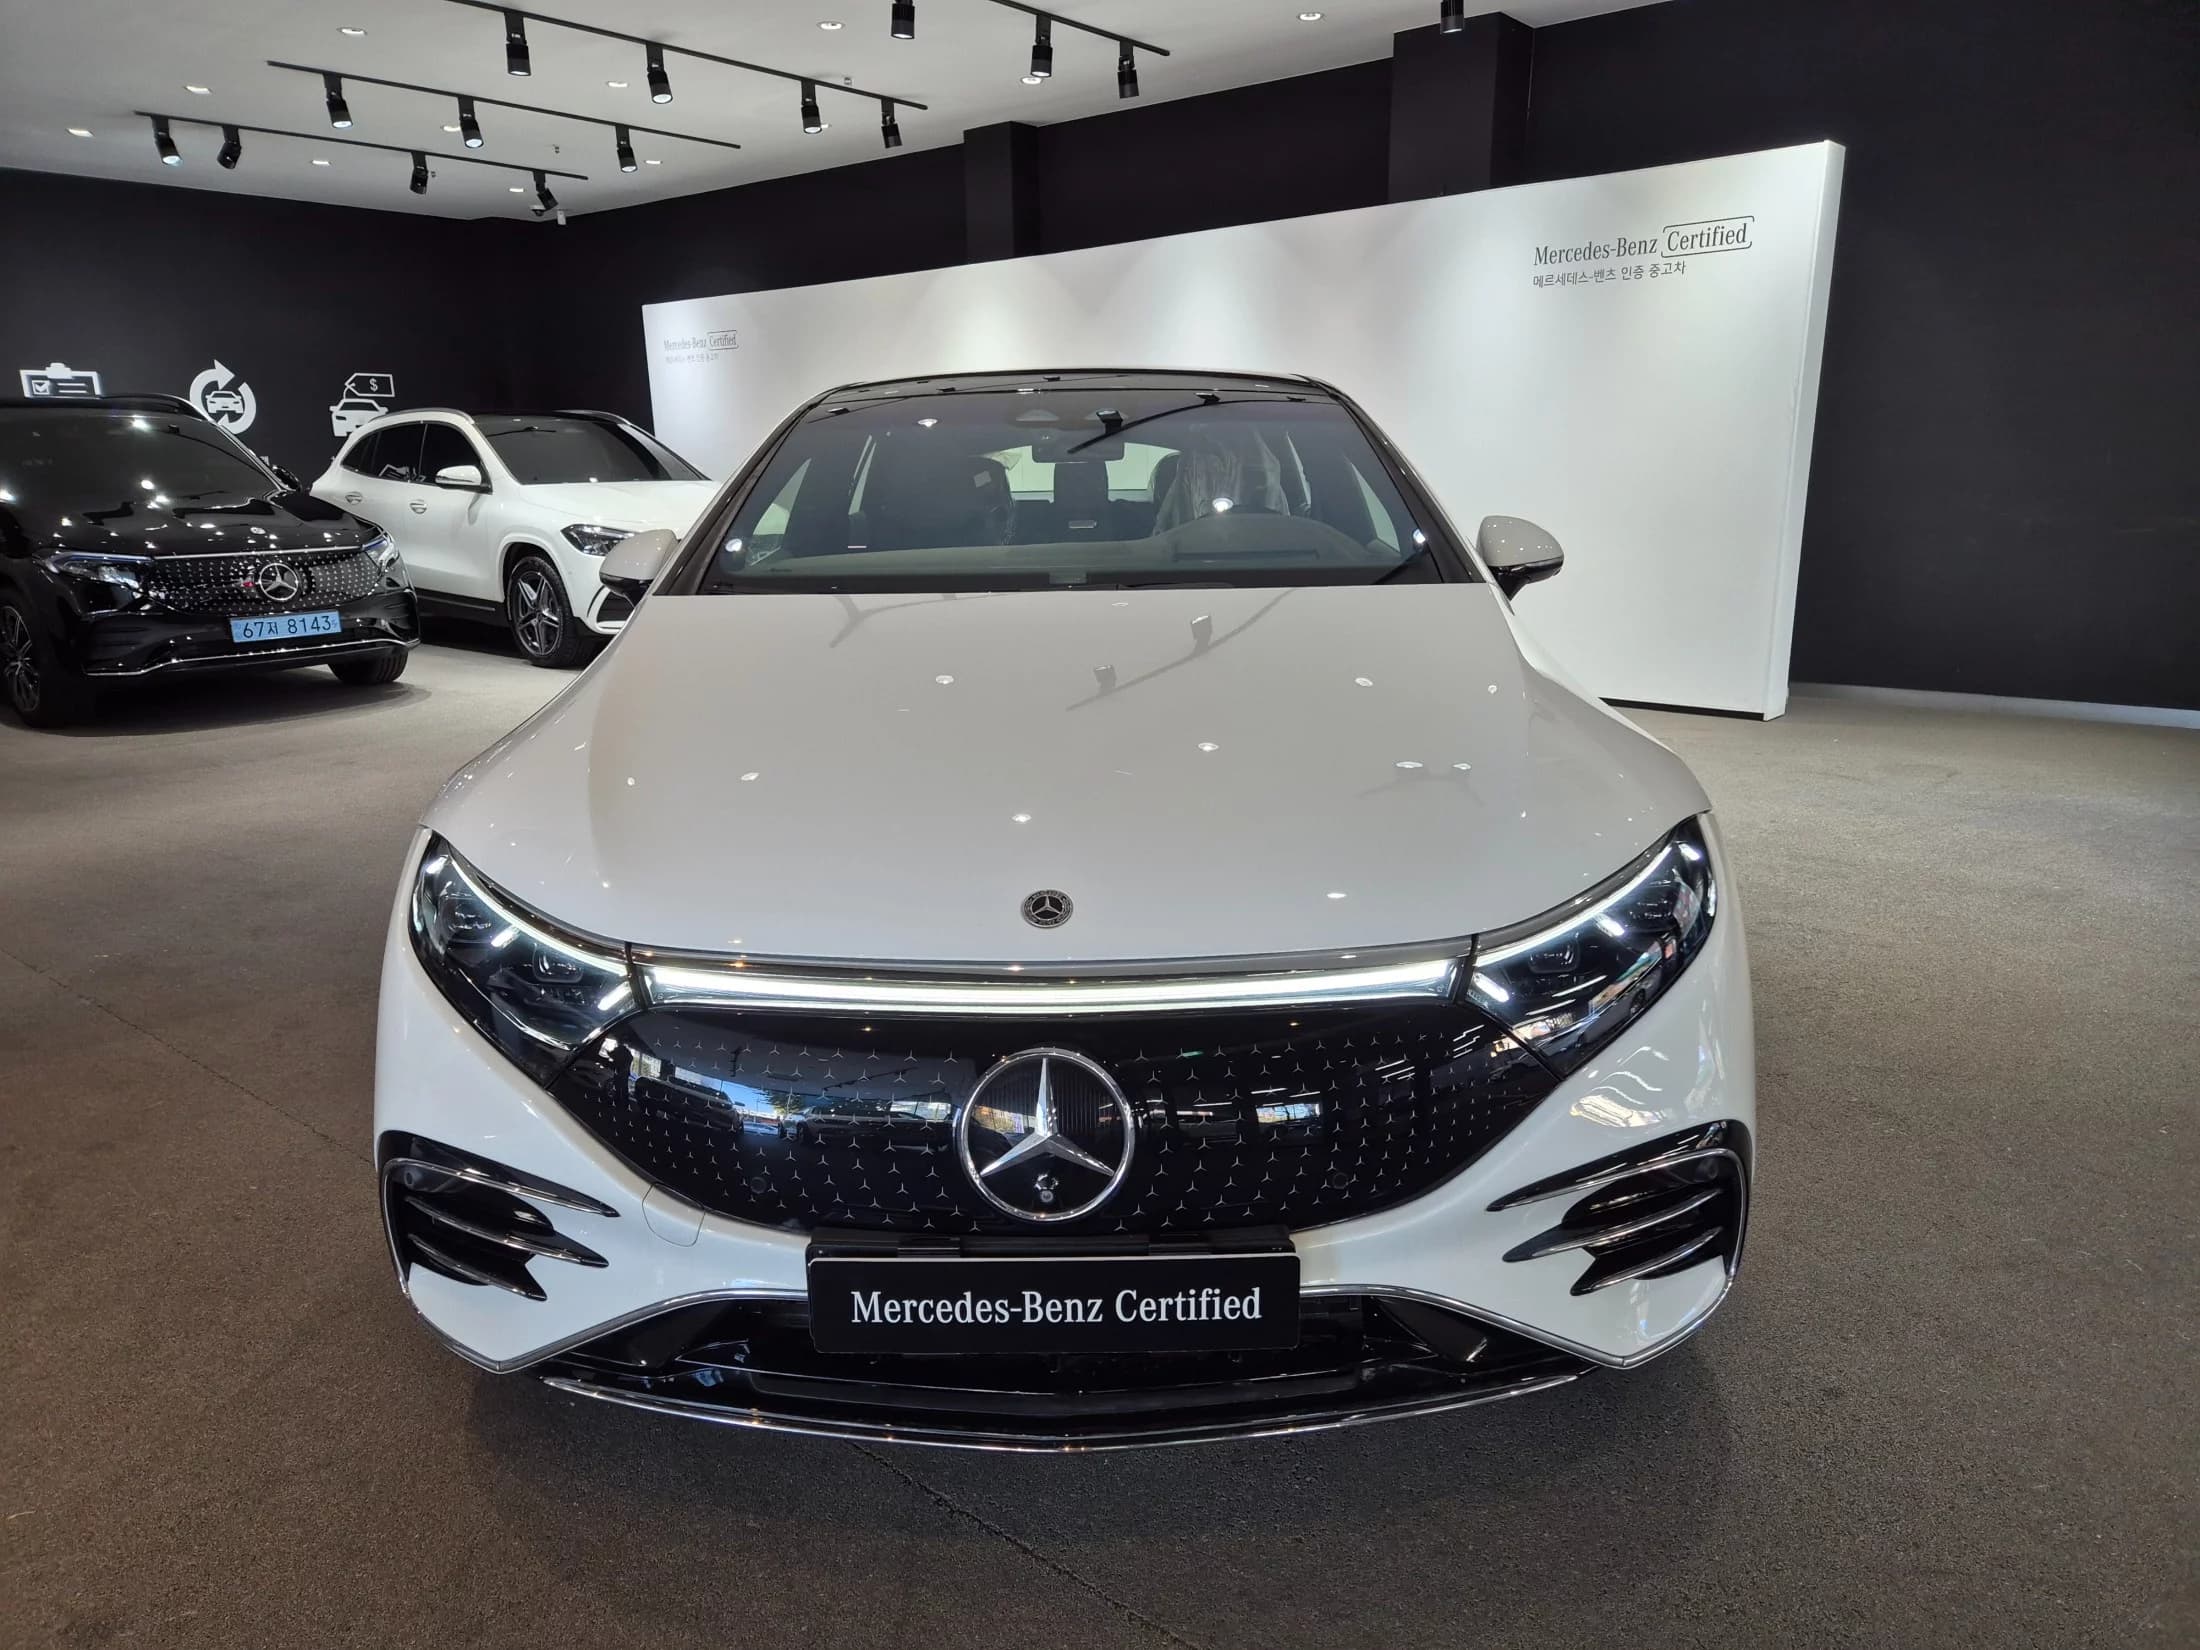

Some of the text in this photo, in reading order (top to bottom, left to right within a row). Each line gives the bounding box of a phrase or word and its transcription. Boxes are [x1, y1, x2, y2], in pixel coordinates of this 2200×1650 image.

[1534, 223, 1747, 265] Mercedes-Benz Certified
[1533, 261, 1687, 288] 메르세데스-벤츠 인증 중고차
[710, 334, 736, 347] Certified
[243, 615, 331, 638] 67저 8143
[851, 1286, 1262, 1324] Mercedes-Benz Certified
